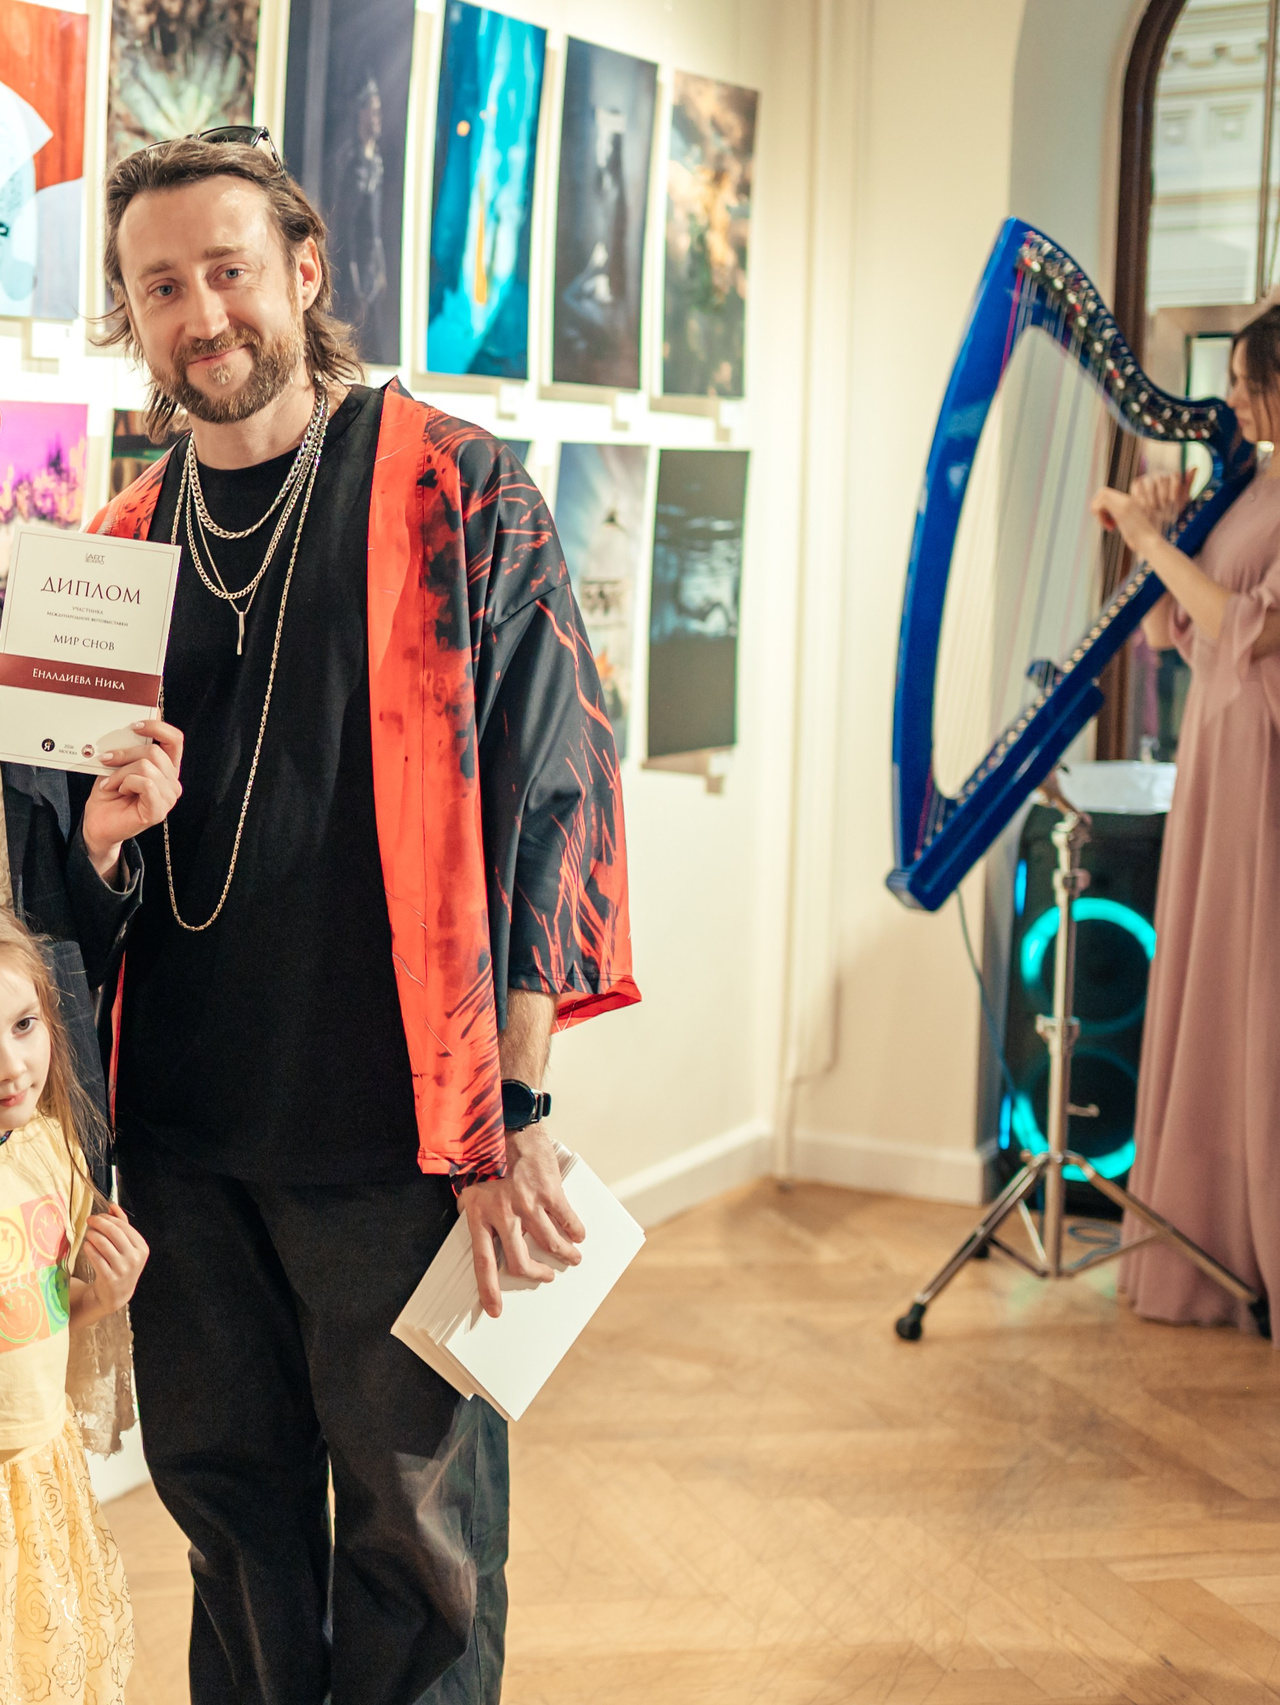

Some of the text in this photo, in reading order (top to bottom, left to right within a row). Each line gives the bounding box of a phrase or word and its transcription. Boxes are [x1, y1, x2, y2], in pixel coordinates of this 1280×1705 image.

[40, 576, 140, 605] ДИПЛОМ
[72, 606, 103, 615] УЧАСТНИКА
[53, 634, 115, 651] МИР СНОВ
